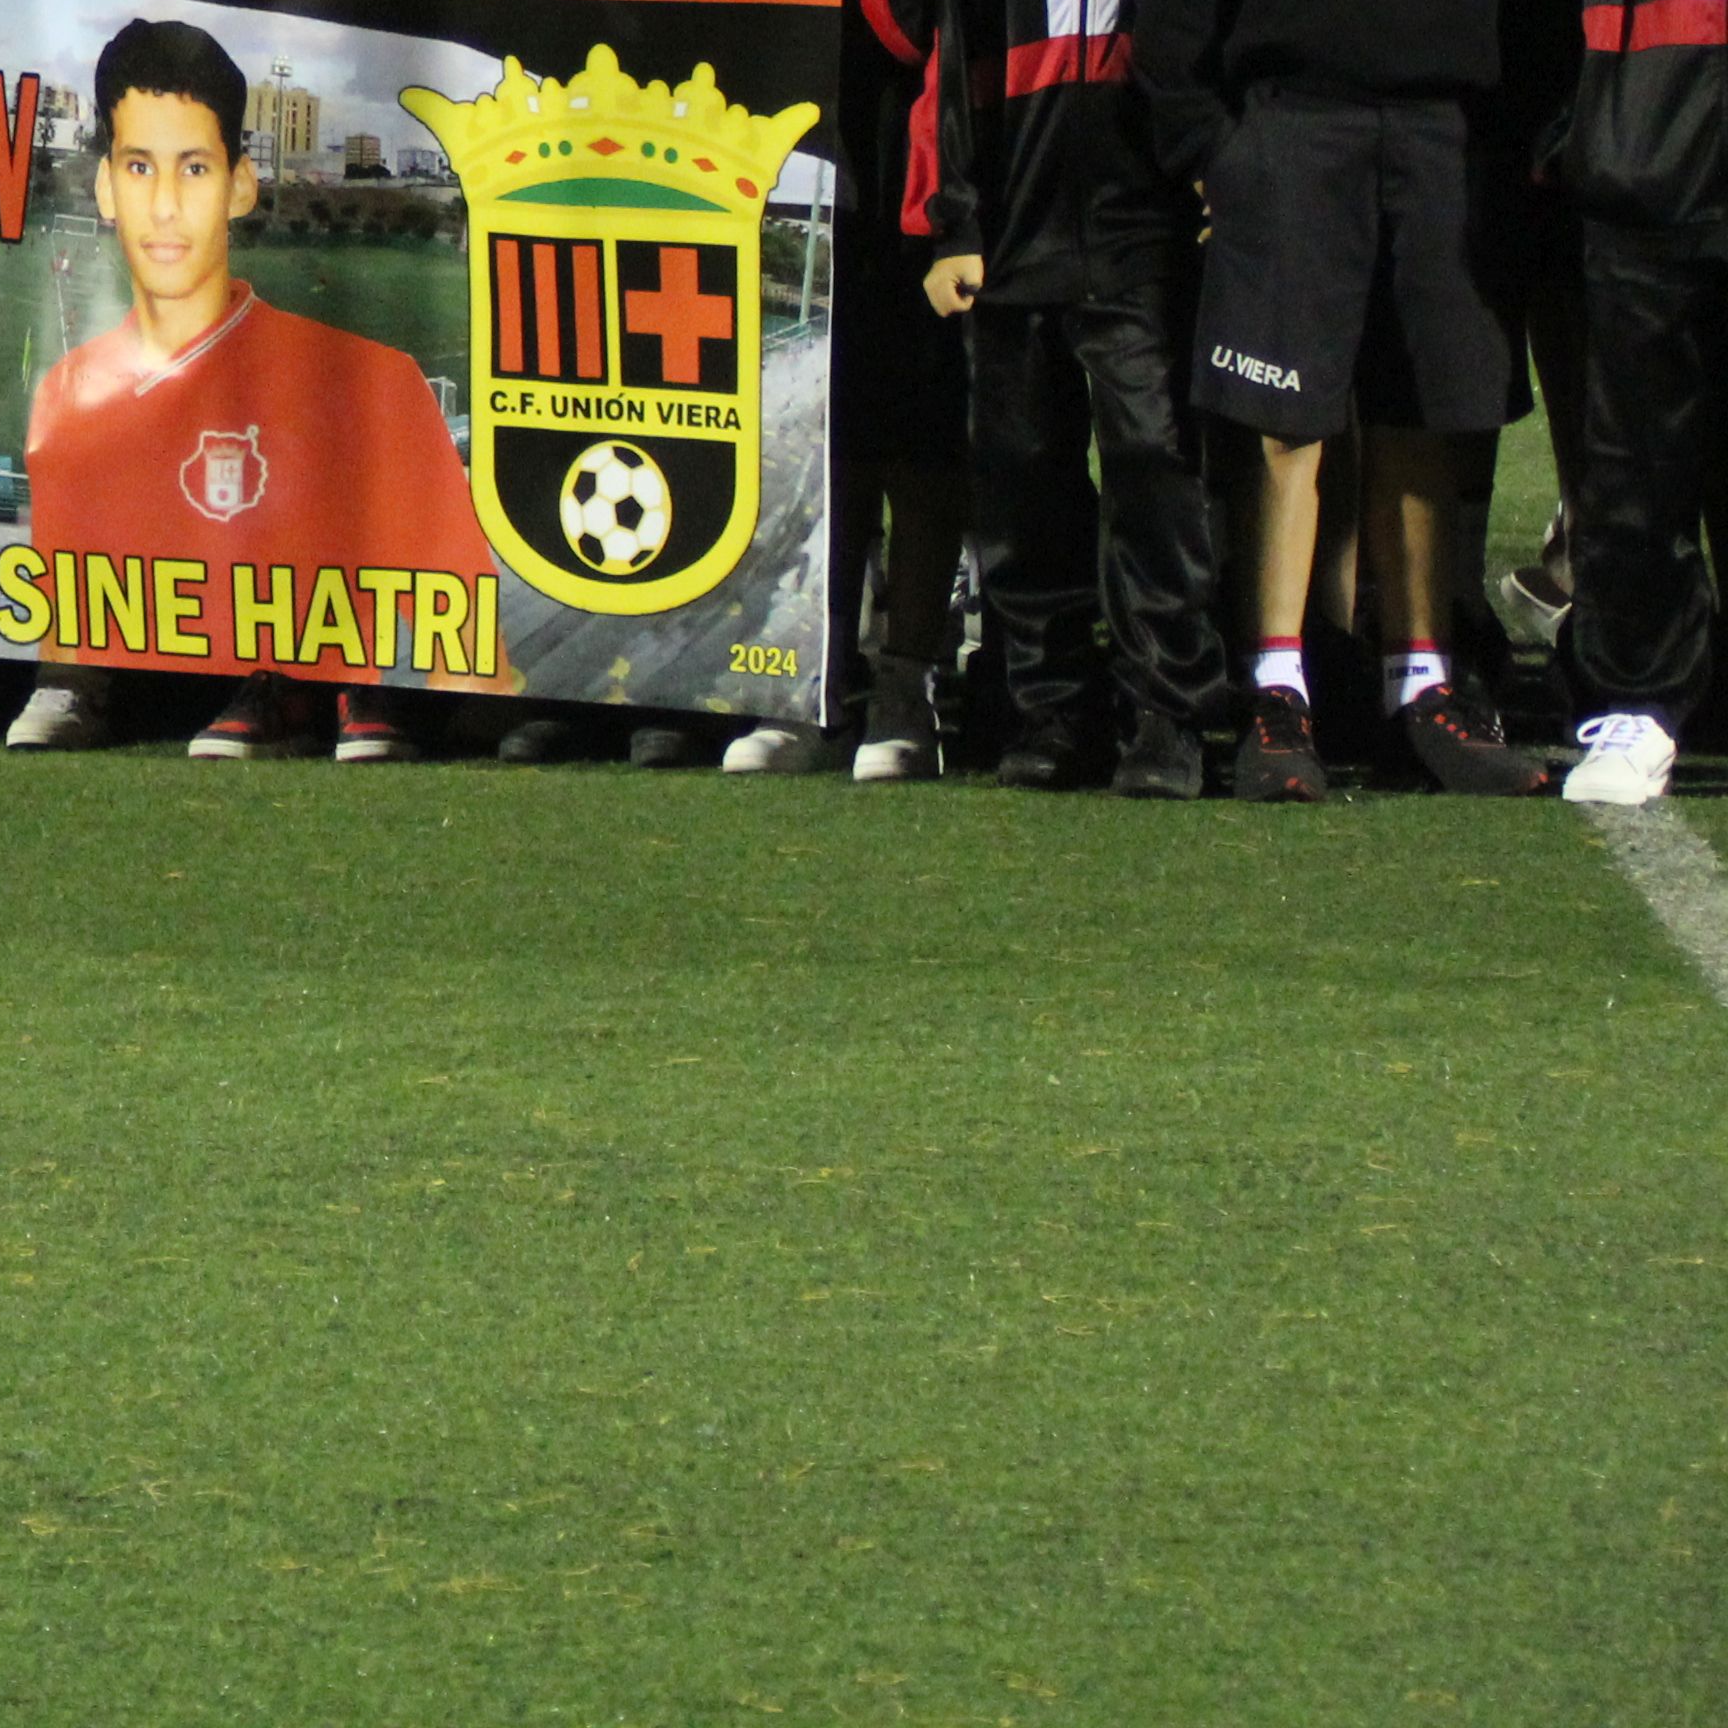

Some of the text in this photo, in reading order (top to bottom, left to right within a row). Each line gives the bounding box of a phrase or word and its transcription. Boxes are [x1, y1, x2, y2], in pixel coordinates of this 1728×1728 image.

[1211, 345, 1301, 392] U.VIERA
[490, 390, 742, 430] C.F. UNIÓN VIERA
[231, 562, 499, 676] HATRI
[729, 642, 798, 678] 2024
